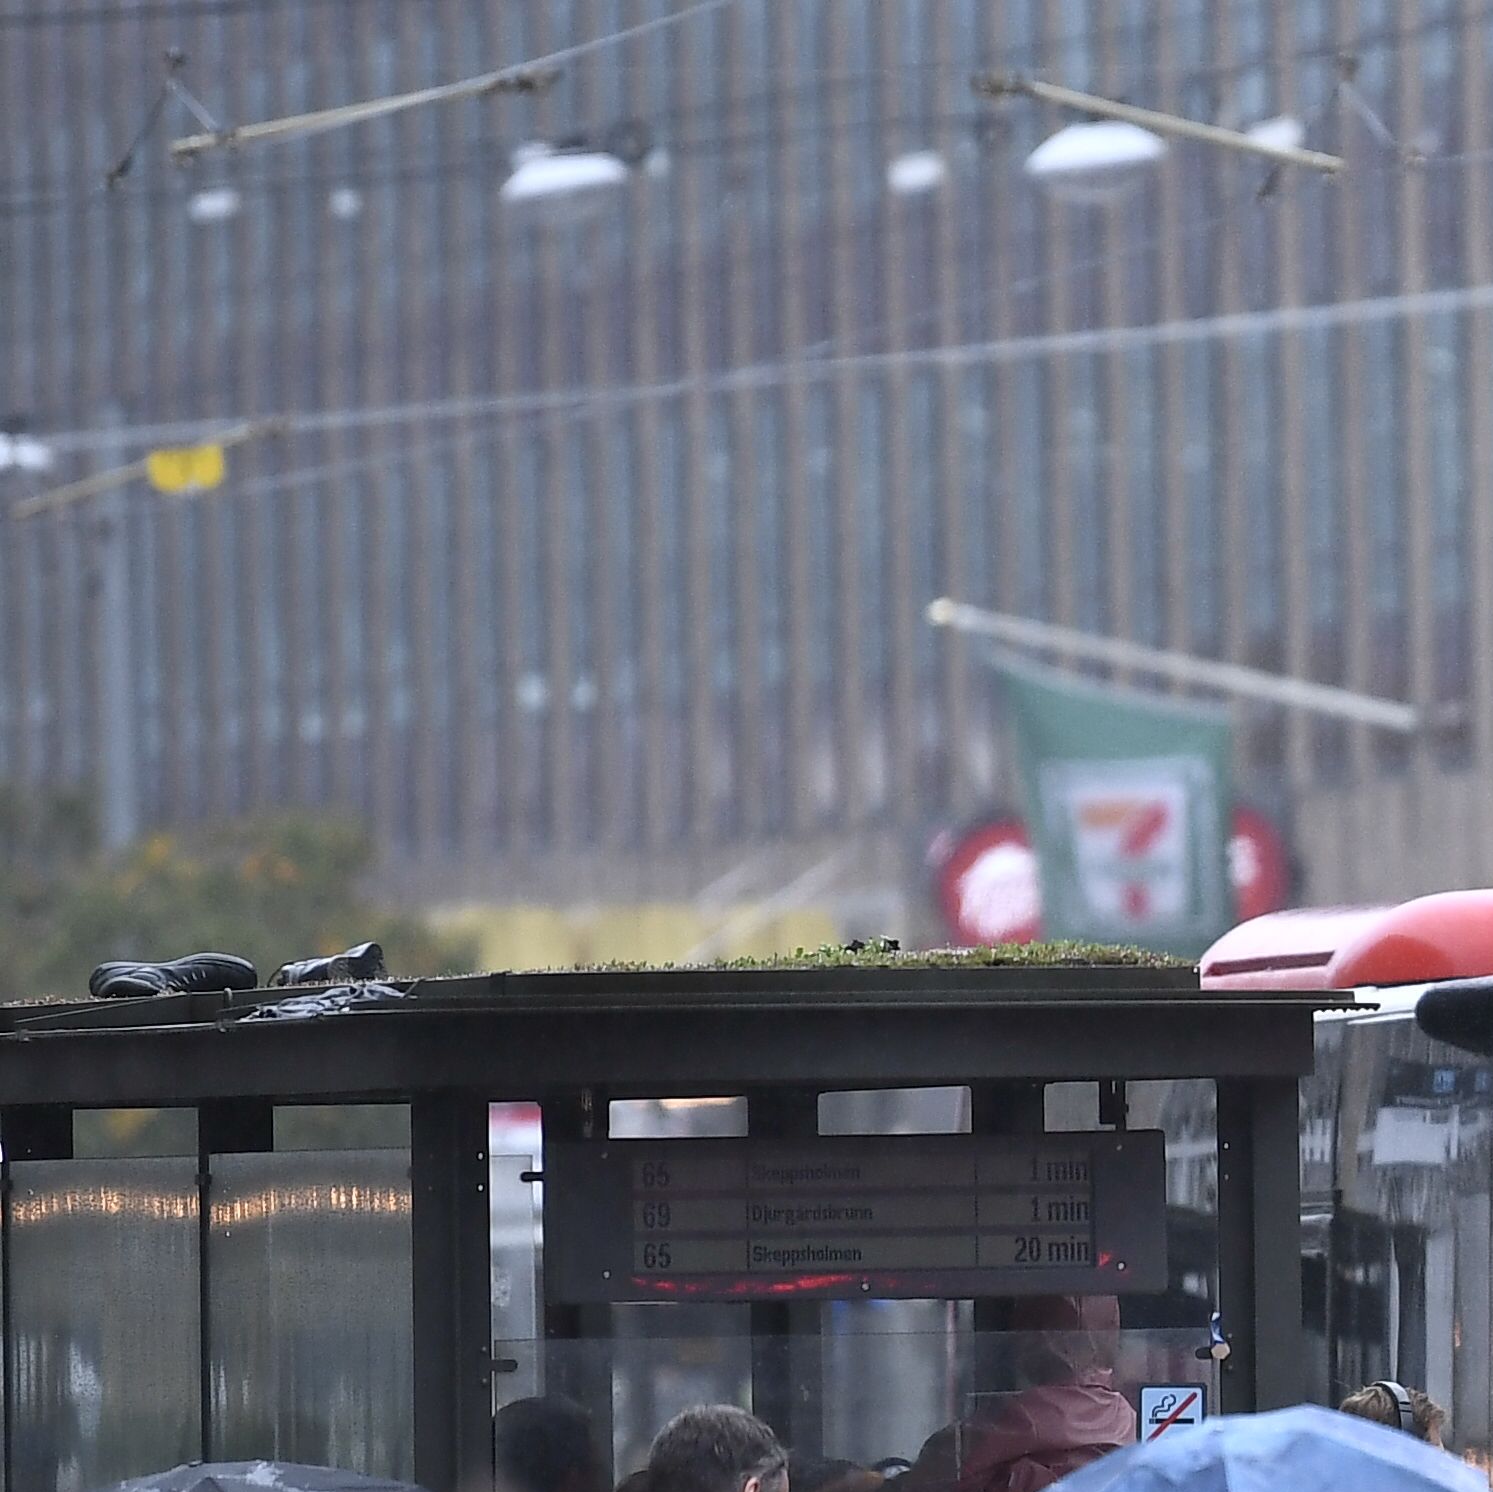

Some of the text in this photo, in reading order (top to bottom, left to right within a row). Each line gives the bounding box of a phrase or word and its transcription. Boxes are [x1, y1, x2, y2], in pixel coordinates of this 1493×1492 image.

[641, 1162, 671, 1188] 65
[1046, 1157, 1088, 1181] min
[642, 1203, 671, 1229] 69
[1031, 1196, 1040, 1221] 1
[1047, 1195, 1089, 1222] min
[643, 1235, 1089, 1269] 65 Skeppsholmen 20 min
